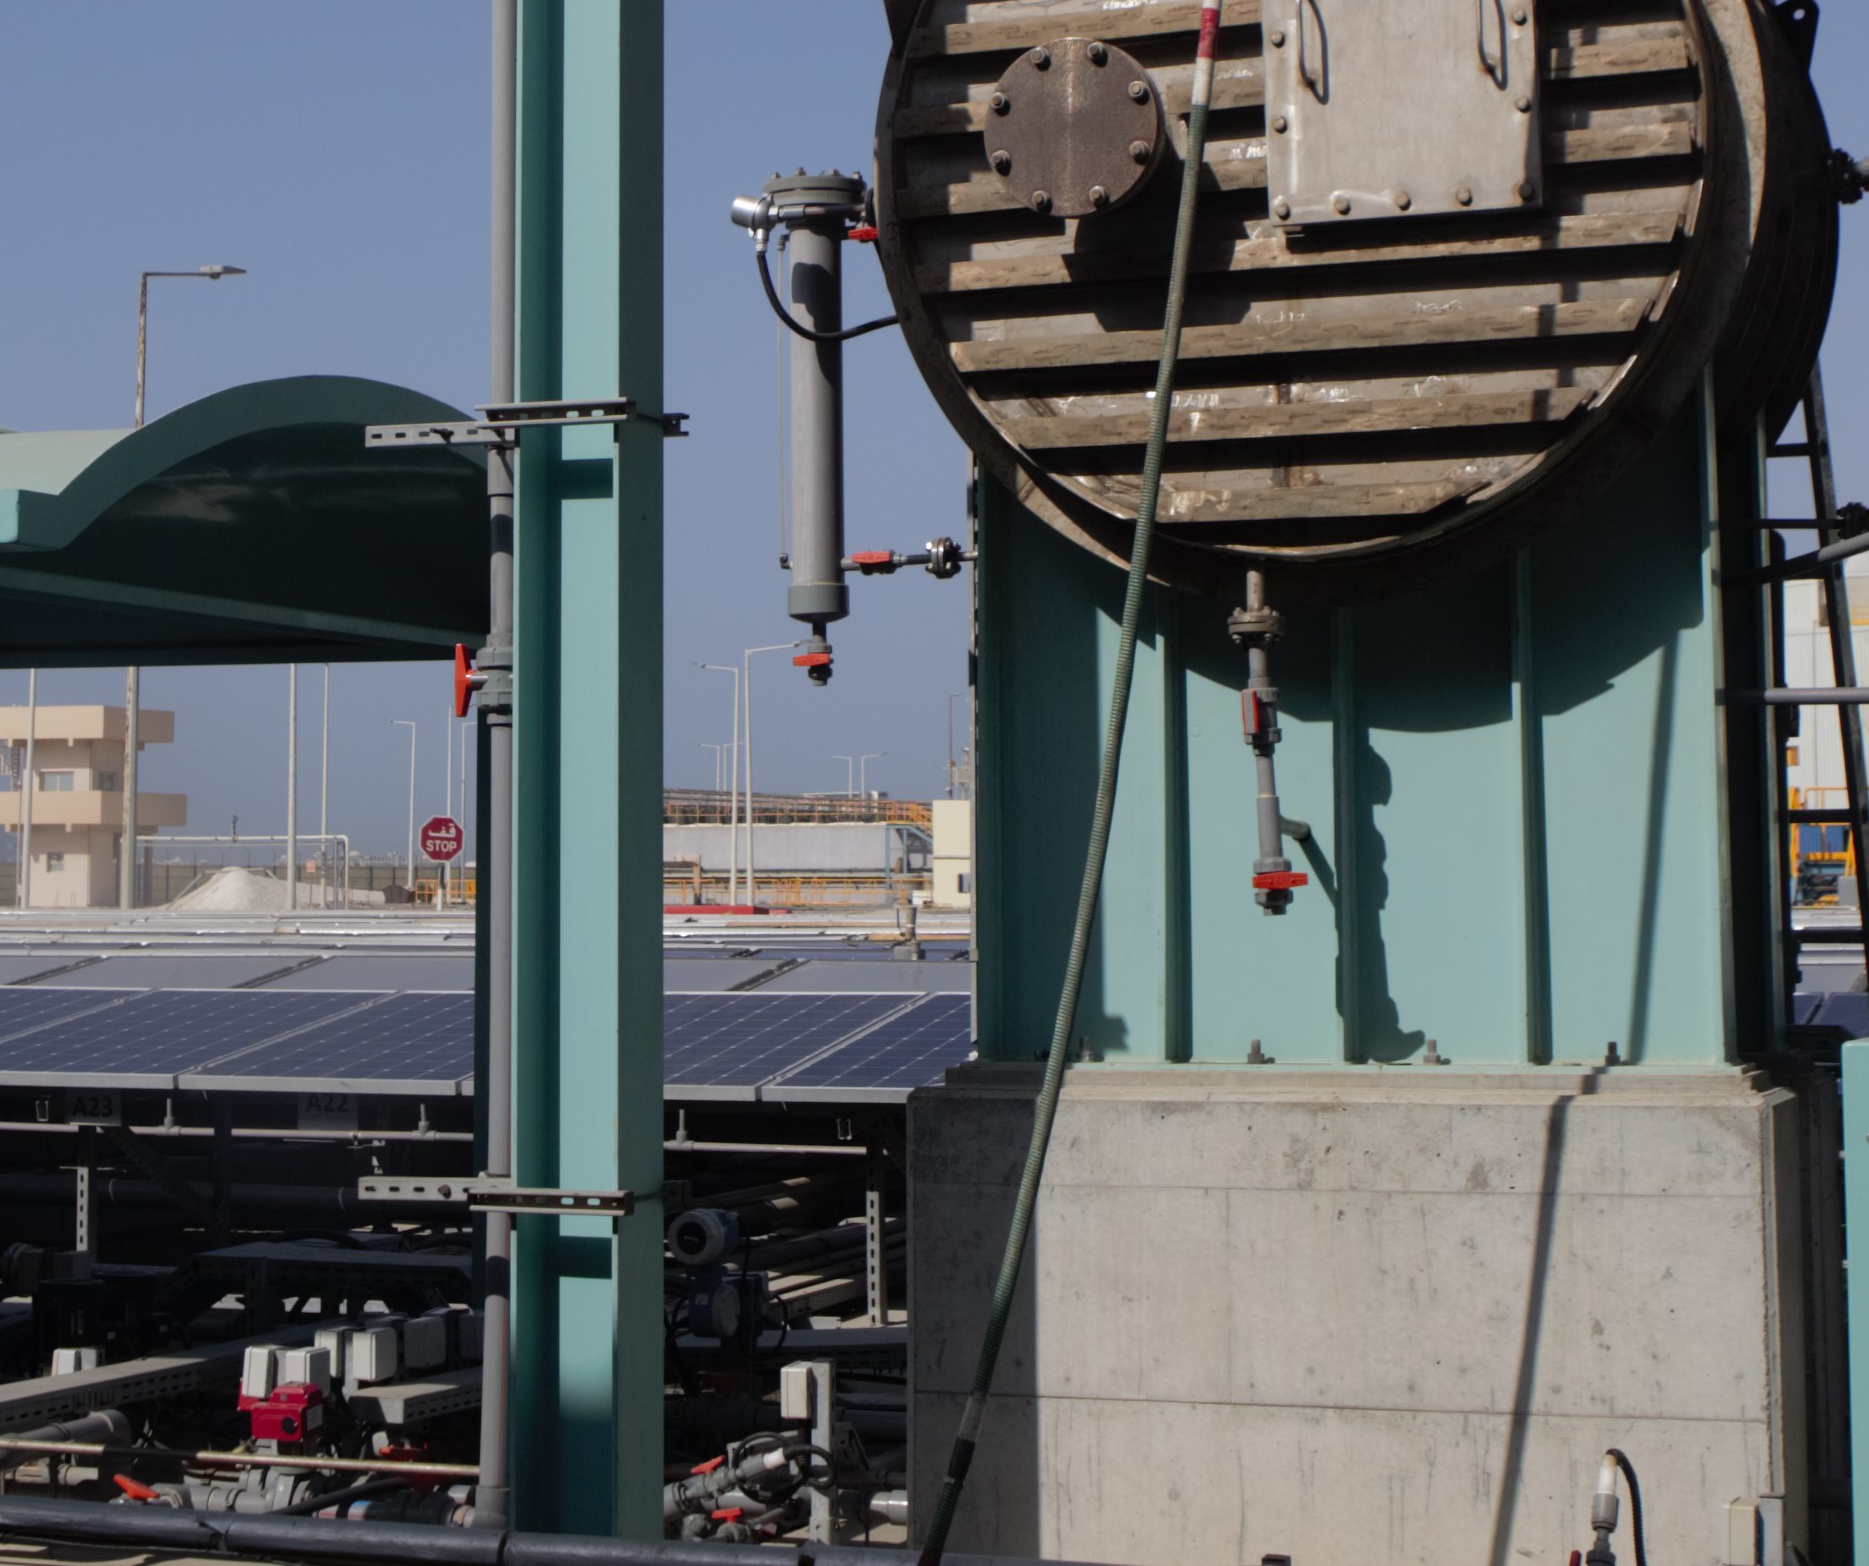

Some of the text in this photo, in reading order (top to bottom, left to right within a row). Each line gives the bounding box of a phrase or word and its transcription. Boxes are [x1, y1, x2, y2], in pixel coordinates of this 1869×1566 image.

[428, 823, 456, 838] قف
[426, 840, 457, 852] STOP
[71, 1097, 113, 1117] A23
[305, 1092, 350, 1113] A22
